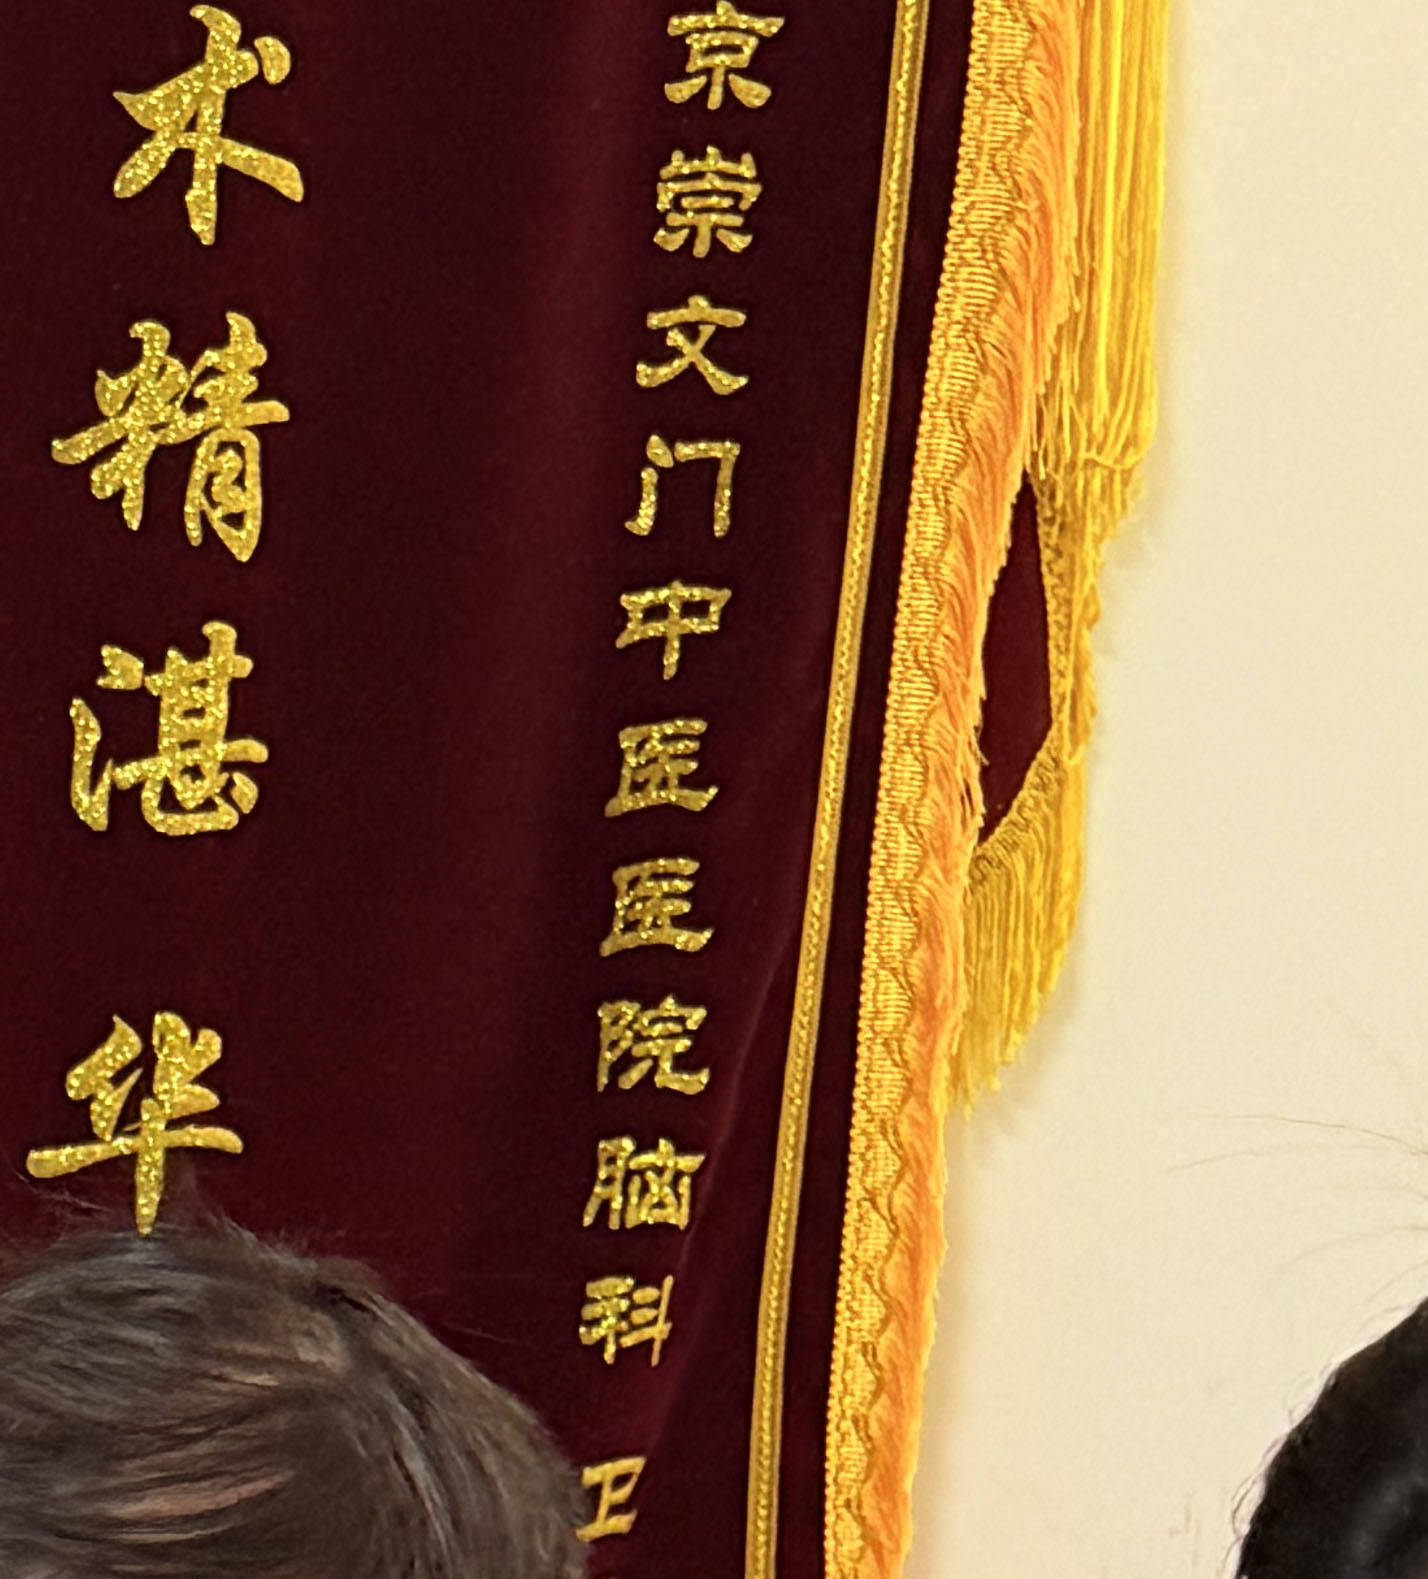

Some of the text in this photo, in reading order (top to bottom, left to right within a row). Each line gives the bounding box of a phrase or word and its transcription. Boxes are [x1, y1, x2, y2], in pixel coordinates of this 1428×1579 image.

[27, 5, 303, 1235] 术精湛 华
[579, 0, 785, 1366] 京崇文门中医医院脑科
